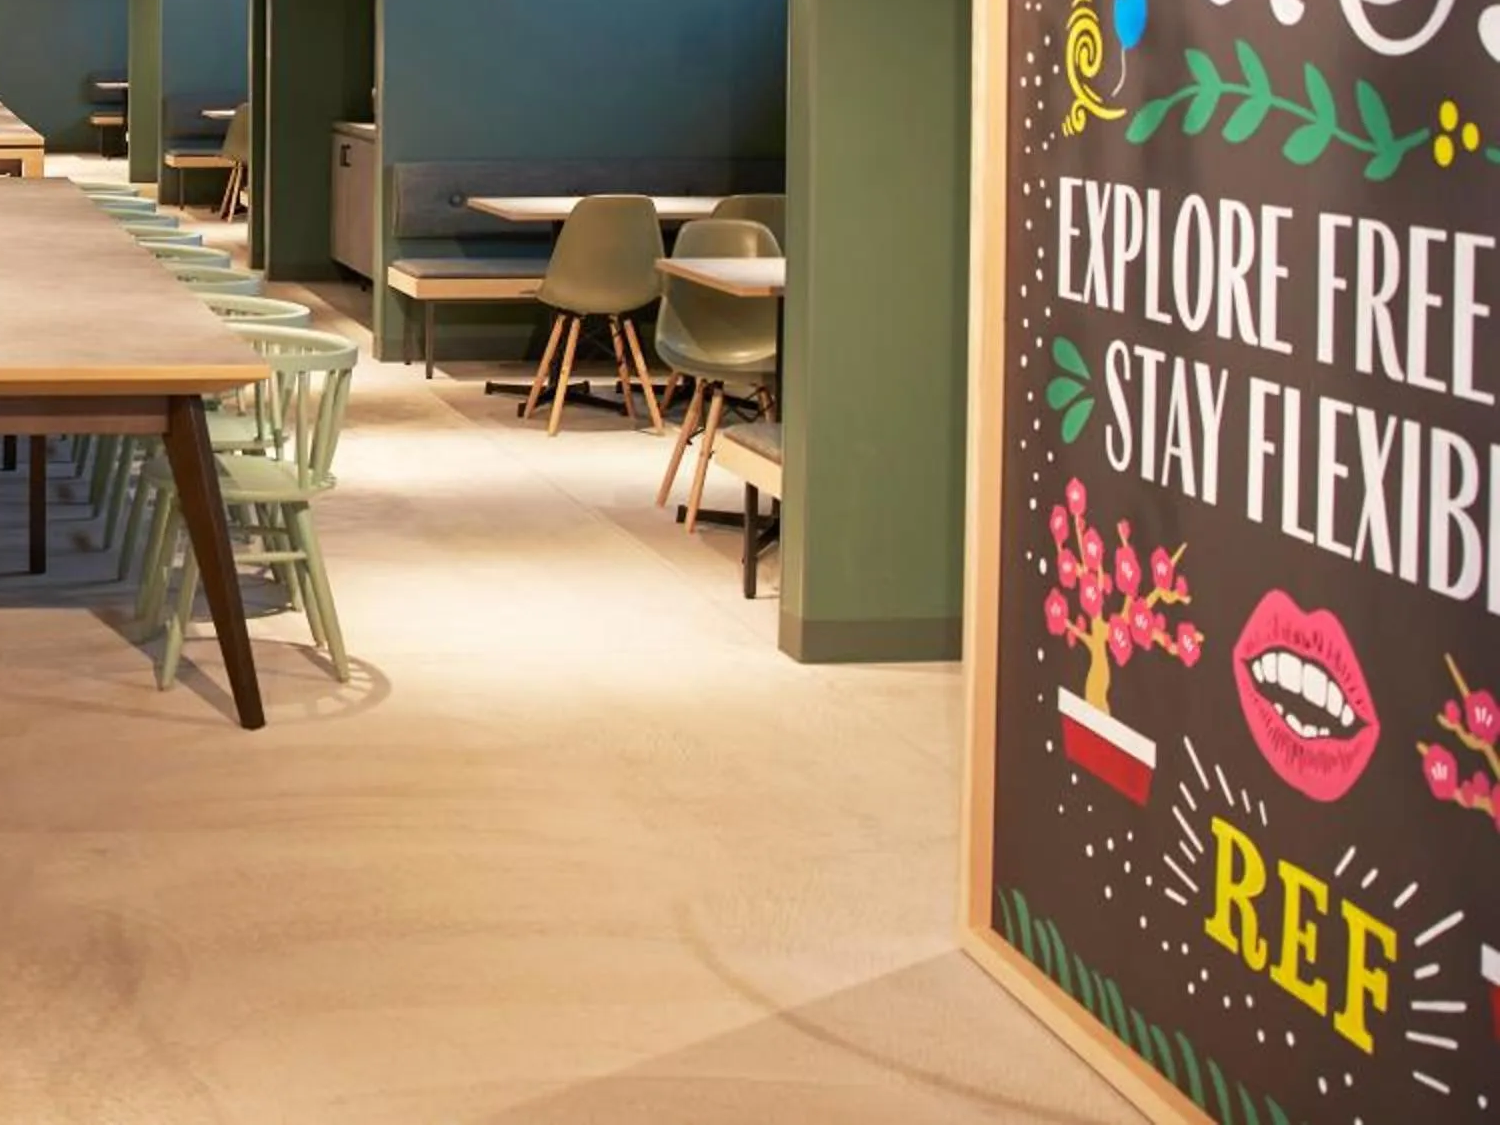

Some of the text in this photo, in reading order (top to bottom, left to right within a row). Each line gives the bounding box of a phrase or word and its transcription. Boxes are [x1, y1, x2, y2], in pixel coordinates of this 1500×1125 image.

[1058, 177, 1496, 406] EXPLORE FREE
[1105, 339, 1229, 506] STAY
[1205, 816, 1398, 1055] REF
